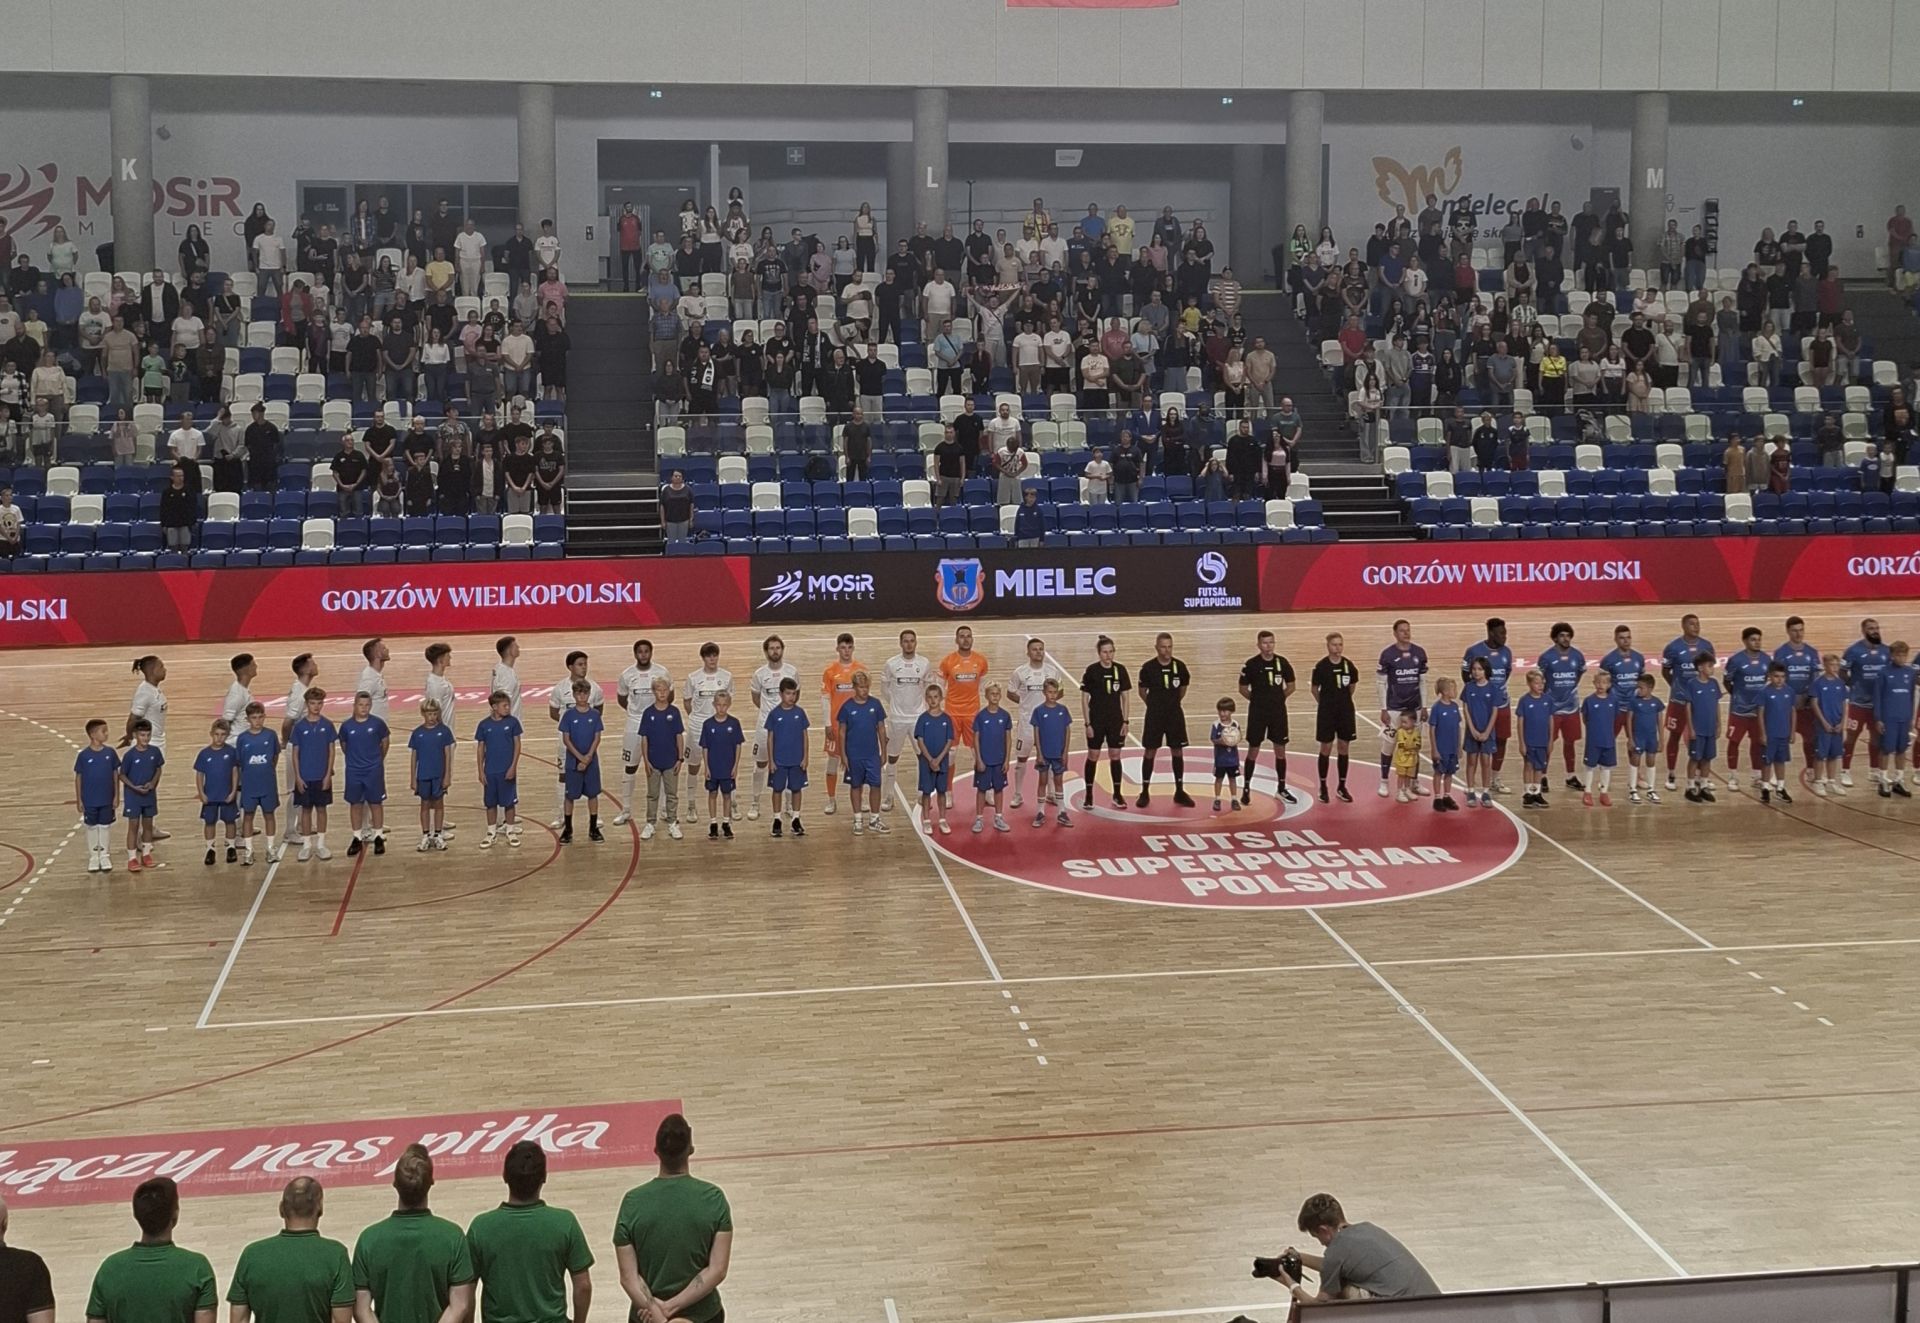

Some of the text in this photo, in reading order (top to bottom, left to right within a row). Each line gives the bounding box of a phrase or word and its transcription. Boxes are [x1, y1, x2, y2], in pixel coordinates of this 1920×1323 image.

[121, 158, 138, 181] K
[927, 166, 939, 188] L
[1646, 167, 1664, 189] M
[79, 221, 246, 237] MLEC
[995, 567, 1117, 598] MIELEC
[1362, 558, 1642, 585] GORZÓW WIELKOPOLSKI
[808, 574, 876, 593] MOSiR
[1197, 586, 1228, 597] FUTSAL
[321, 581, 642, 611] GORZÓW WIELKOPOLSKI
[808, 592, 876, 601] MIELEC
[1183, 597, 1242, 608] SUPERPUCHAR
[1729, 726, 1736, 737] 7
[752, 743, 759, 756] 8
[1141, 829, 1340, 852] FUTSAL
[1062, 846, 1461, 878] SUPERPUCHAR
[1181, 870, 1387, 897] POLSKI
[229, 1136, 395, 1172] nas
[373, 1113, 610, 1177] piłka
